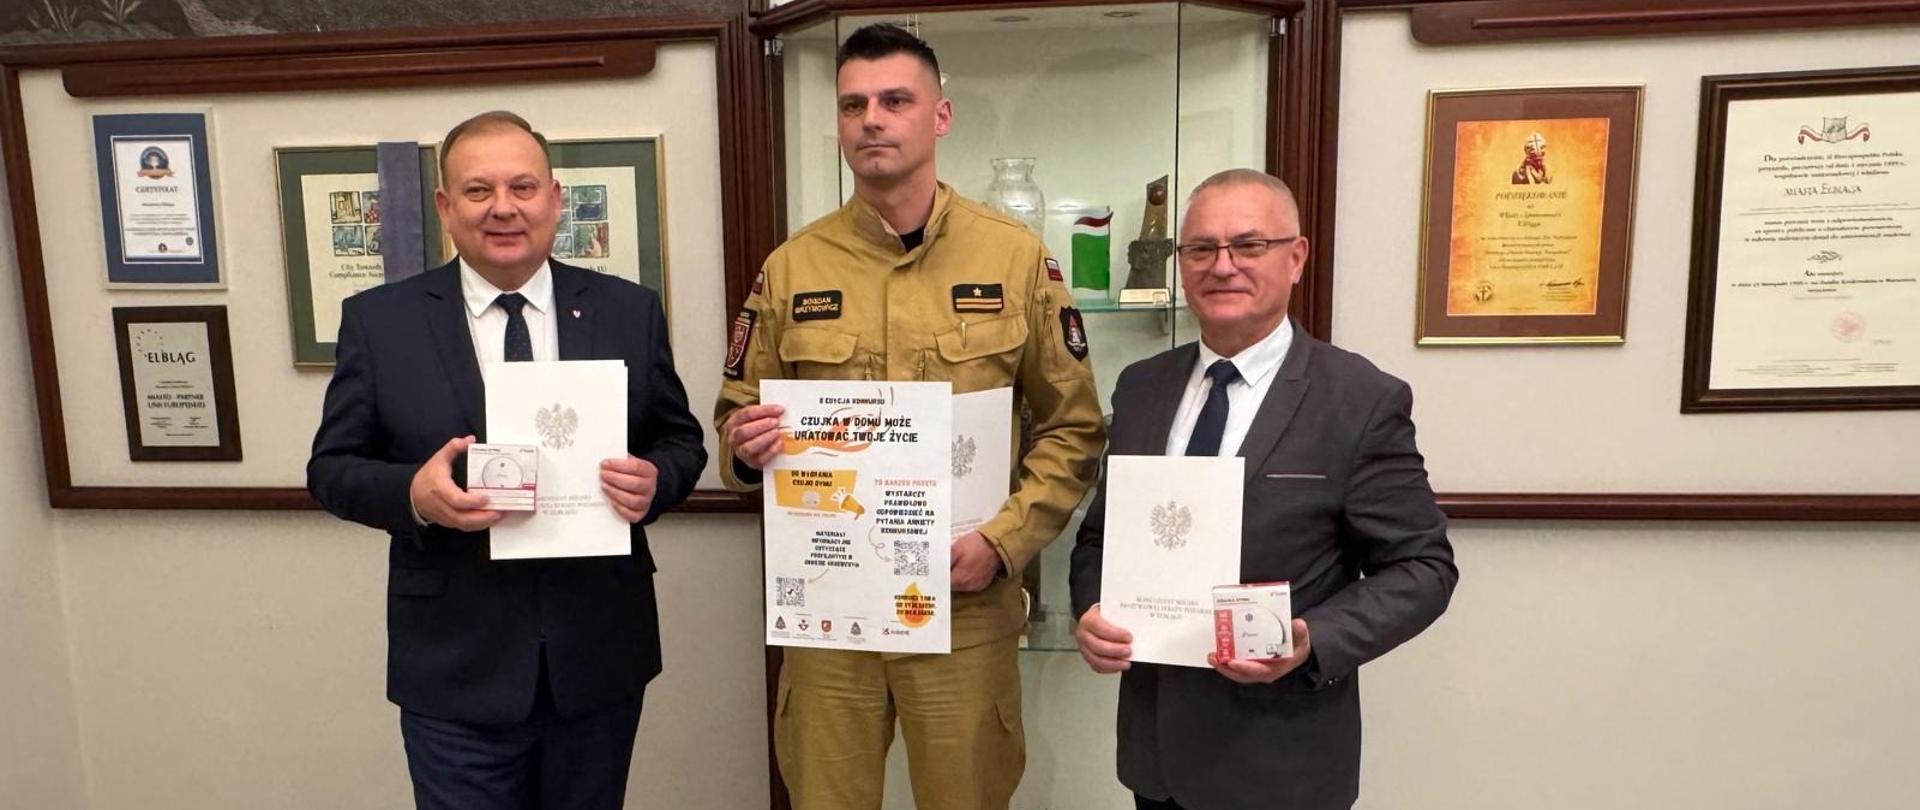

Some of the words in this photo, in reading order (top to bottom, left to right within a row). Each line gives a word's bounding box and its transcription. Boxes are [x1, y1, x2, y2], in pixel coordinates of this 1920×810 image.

[148, 351, 196, 365] ELBLĄG
[800, 416, 840, 426] CZUJKA
[842, 416, 852, 427] W
[854, 416, 880, 427] DOMU
[884, 415, 912, 428] MOŻE
[794, 428, 850, 441] URATOWAĆ
[852, 430, 886, 442] TWOJE
[889, 429, 919, 443] ŻYCIE
